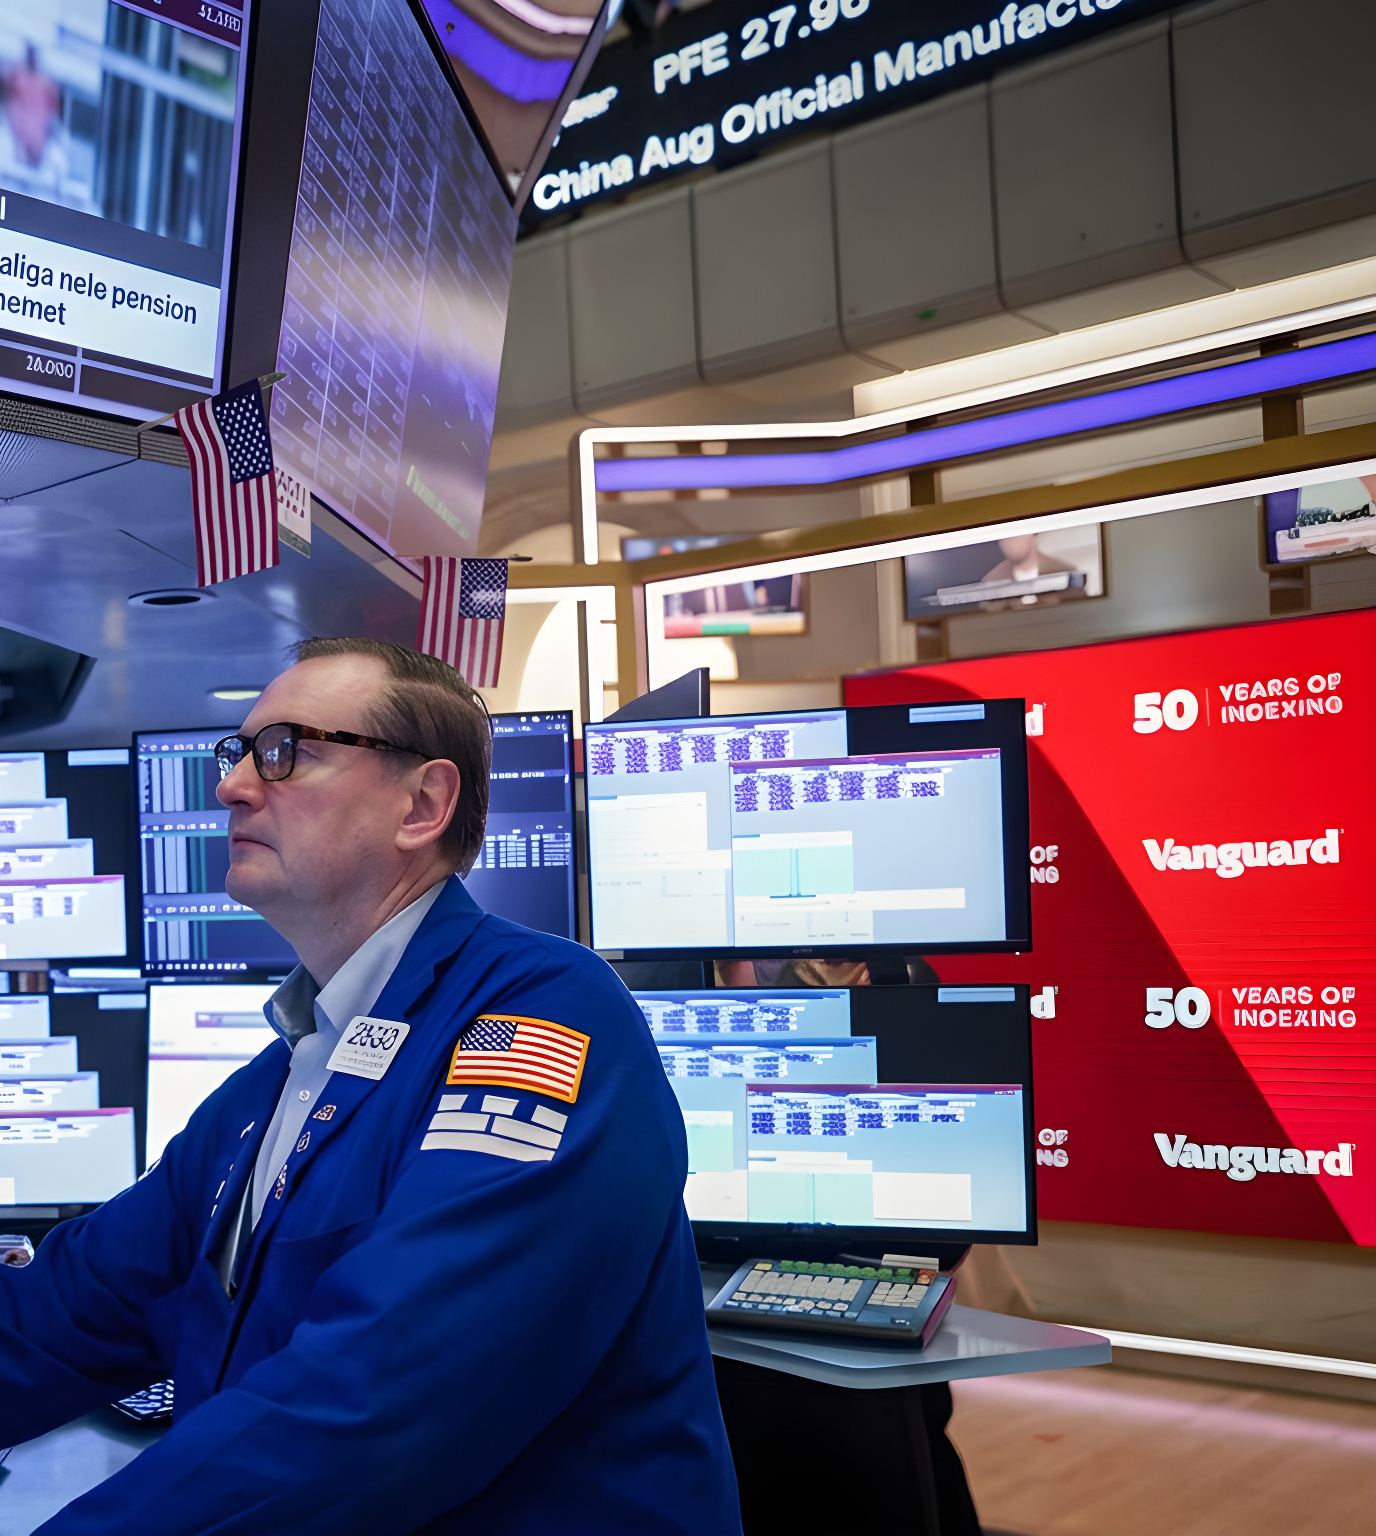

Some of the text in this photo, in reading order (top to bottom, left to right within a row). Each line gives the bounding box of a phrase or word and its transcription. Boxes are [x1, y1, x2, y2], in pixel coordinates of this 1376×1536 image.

[652, 31, 729, 95] PFE
[532, 151, 634, 212] China
[639, 121, 714, 177] Aug
[721, 60, 865, 145] Official
[59, 271, 107, 300] nele
[112, 285, 197, 325] pension
[1132, 688, 1199, 734] 50
[1142, 829, 1341, 878] Vanguard
[1144, 986, 1210, 1029] 50
[1153, 1132, 1354, 1181] Vanguard
